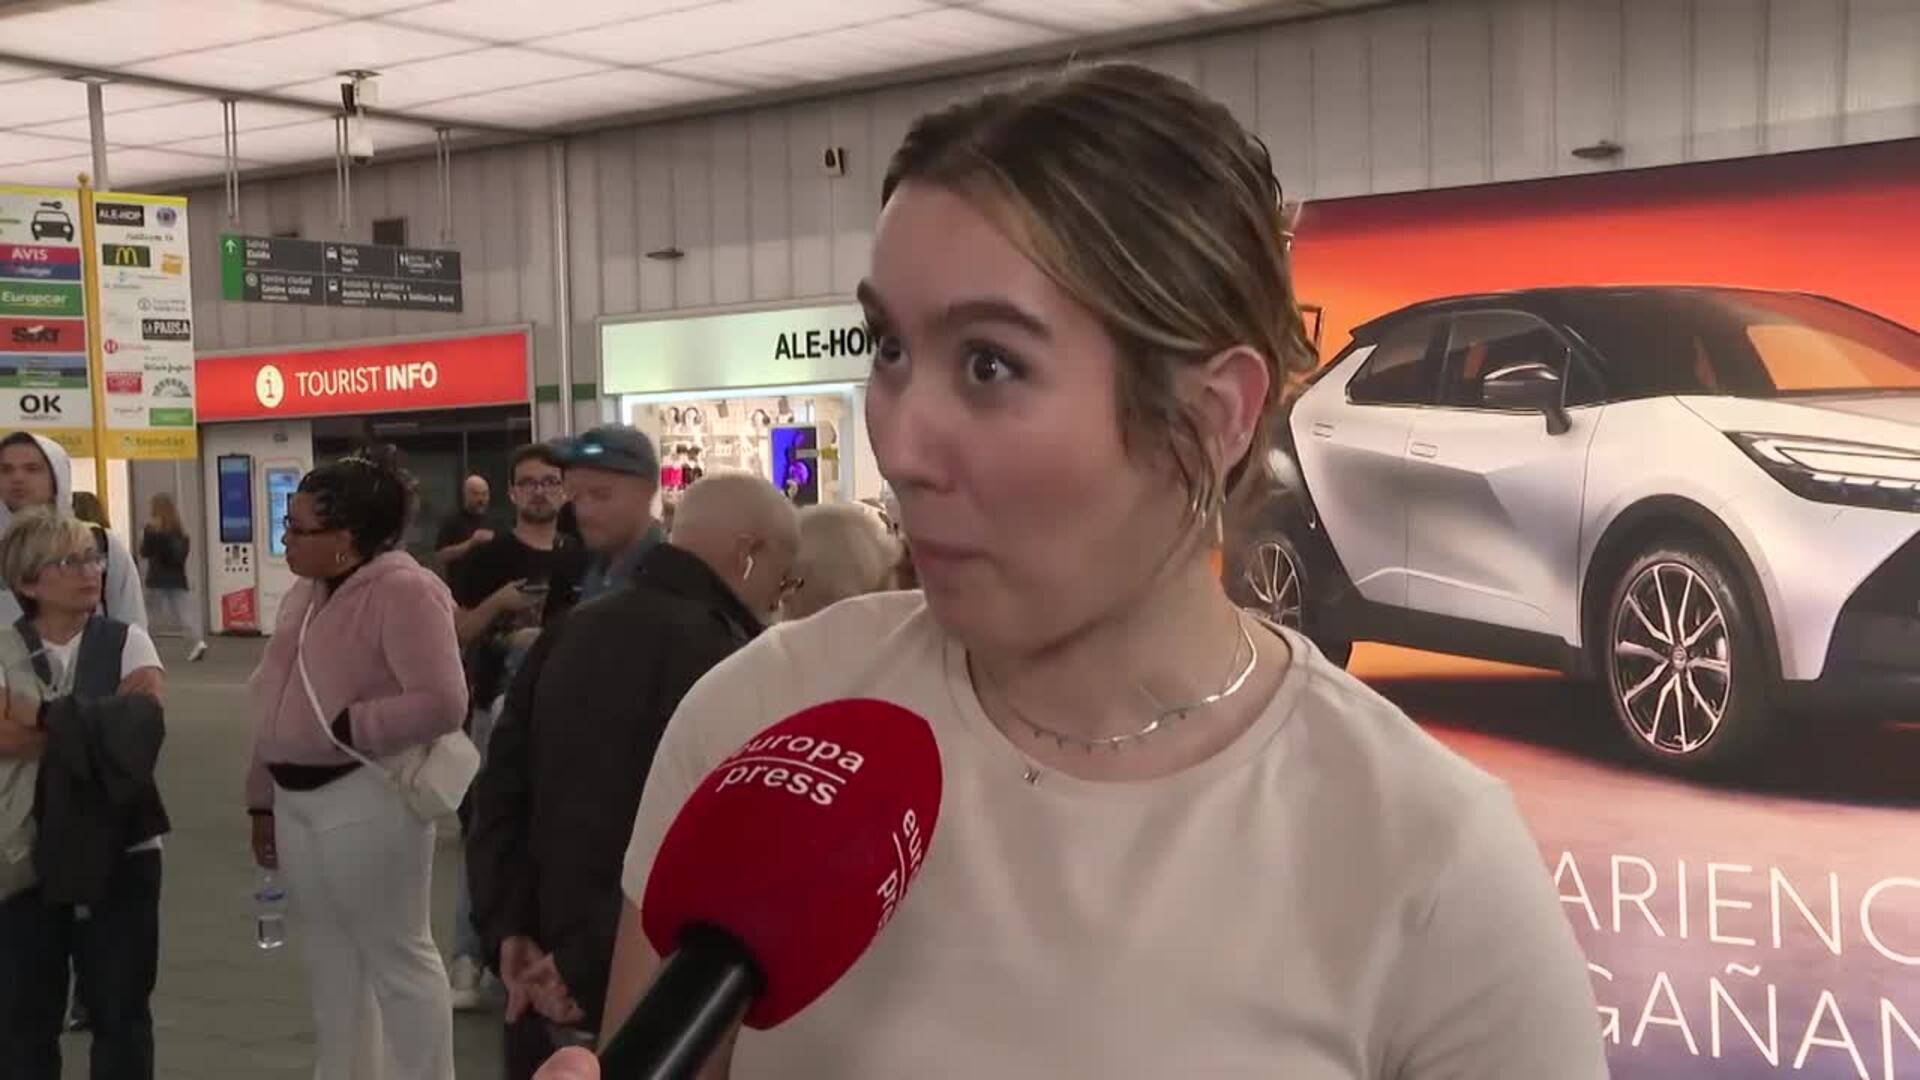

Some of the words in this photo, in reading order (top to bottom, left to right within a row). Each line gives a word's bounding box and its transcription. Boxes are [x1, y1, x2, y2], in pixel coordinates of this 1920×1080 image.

[12, 248, 48, 261] AVIS
[2, 291, 68, 305] Europcar
[295, 366, 381, 396] TOURIST
[385, 361, 438, 390] INFO
[19, 395, 61, 413] OK
[742, 735, 865, 774] uropa
[715, 766, 837, 805] press
